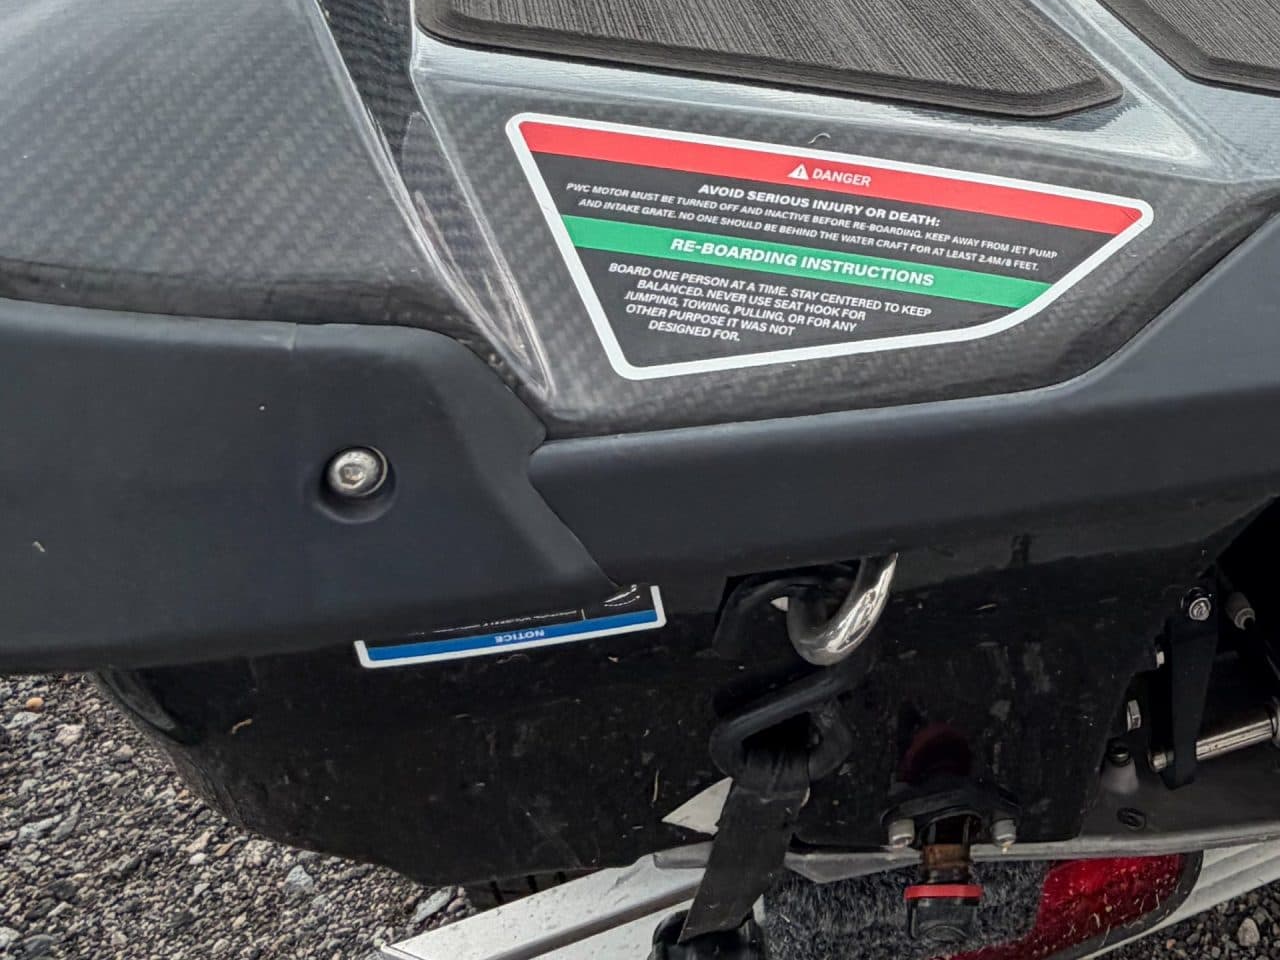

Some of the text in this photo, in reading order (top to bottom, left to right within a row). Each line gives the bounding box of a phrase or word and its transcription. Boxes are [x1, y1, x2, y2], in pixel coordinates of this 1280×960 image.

[812, 167, 872, 187] DANGER
[566, 182, 590, 192] PWC
[591, 185, 629, 197] MOTOR
[630, 190, 660, 201] MUST
[660, 194, 675, 203] BE
[676, 196, 717, 209] TURNED
[718, 202, 739, 211] OFF
[739, 205, 763, 215] AND
[763, 208, 810, 222] INACTIVE
[811, 215, 851, 228] BEFORE
[924, 231, 951, 242] KEEP
[951, 235, 980, 246] AWAY
[980, 239, 1009, 251] FROM
[1010, 245, 1028, 254] JET
[1028, 247, 1057, 258] PUMP
[697, 184, 940, 226] AVOID SERIOUS INJURY OR DEATH:
[578, 198, 602, 208] AND
[602, 201, 640, 213] INTAKE
[677, 211, 695, 220] NO
[695, 214, 718, 224] ONE
[719, 216, 762, 229] SHOULD
[763, 223, 777, 232] BE
[778, 225, 821, 237] BEHIND
[819, 230, 839, 241] THE
[841, 233, 874, 245] WATER
[875, 239, 909, 250] CRAFT
[909, 243, 931, 254] FOR
[931, 247, 945, 256] AT
[945, 249, 977, 261] LEAST
[670, 238, 934, 286] RE-BOARDING INSTRUCTIONS
[608, 262, 651, 276] BOARD
[652, 268, 679, 280] ONE
[679, 272, 729, 287] PERSON
[729, 279, 746, 289] AT
[745, 282, 755, 291] A
[790, 287, 819, 300] STAY
[819, 292, 882, 310] CENTERED
[884, 301, 899, 312] TO
[900, 304, 931, 317] KEEP
[636, 279, 866, 320] BALANCED. NEVER USE SEAT HOOK FOR
[625, 303, 796, 336] OTHER PURPOSE IT WAS NOT
[647, 319, 740, 341] DESIGNED FOR.
[787, 313, 805, 324] OR
[805, 316, 830, 328] FOR
[831, 319, 857, 331] ANY
[494, 629, 545, 643] NOTICE
